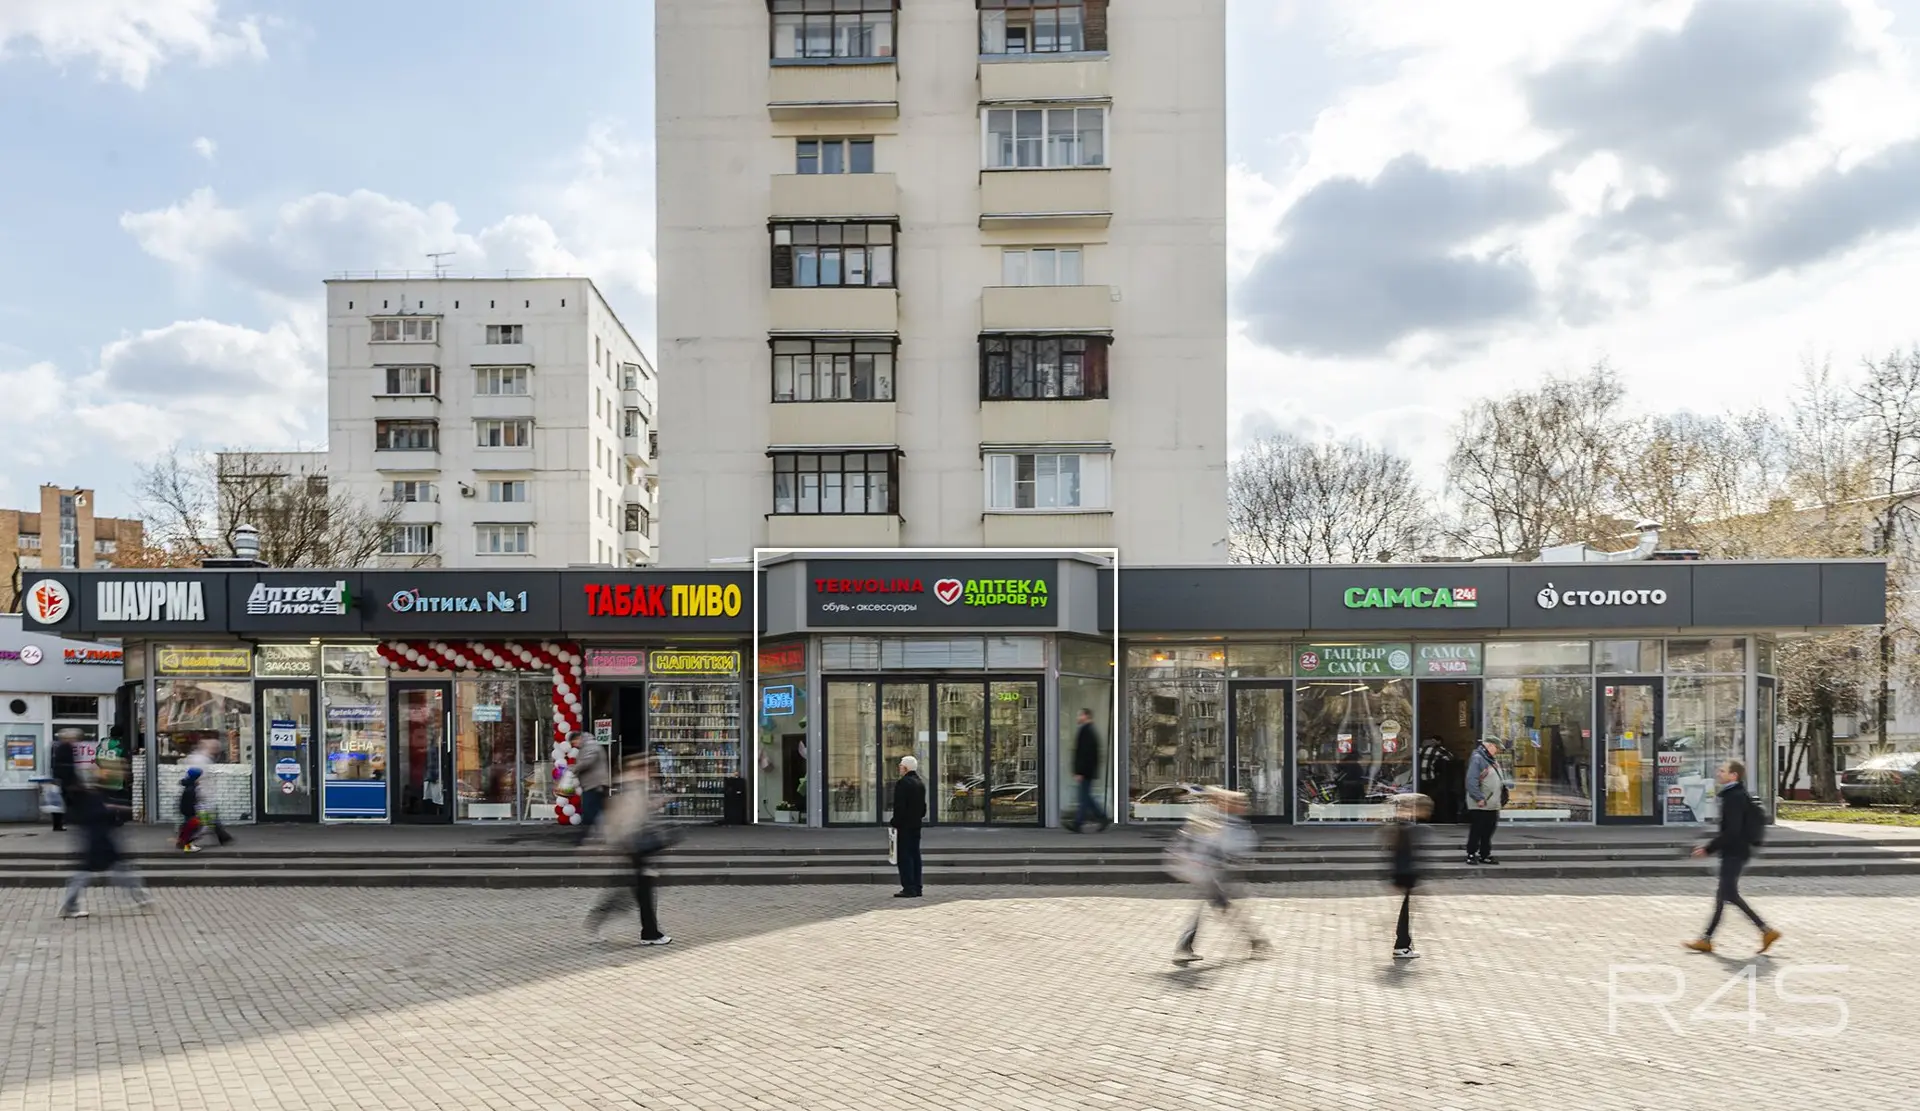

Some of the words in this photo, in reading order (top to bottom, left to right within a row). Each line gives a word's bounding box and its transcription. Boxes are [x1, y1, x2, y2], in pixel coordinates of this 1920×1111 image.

[815, 578, 924, 593] TERVOLINA
[964, 579, 1048, 594] АПТЕКА
[97, 581, 205, 622] ШАУРМА
[584, 584, 666, 617] ТАБАК
[671, 584, 742, 617] ПИВО
[1344, 586, 1454, 608] САМСА
[1562, 589, 1667, 606] СТОЛОТО
[822, 602, 850, 612] обувь
[856, 602, 918, 612] аксессуары
[1323, 648, 1386, 661] ТАНДЫР
[1420, 645, 1476, 658] САМСА
[656, 655, 734, 669] НАПИТКИ
[1302, 654, 1317, 664] 24
[264, 661, 311, 671] ЗАКАЗОВ
[1327, 661, 1381, 673] САМСА
[340, 740, 374, 752] ЦЕНА
